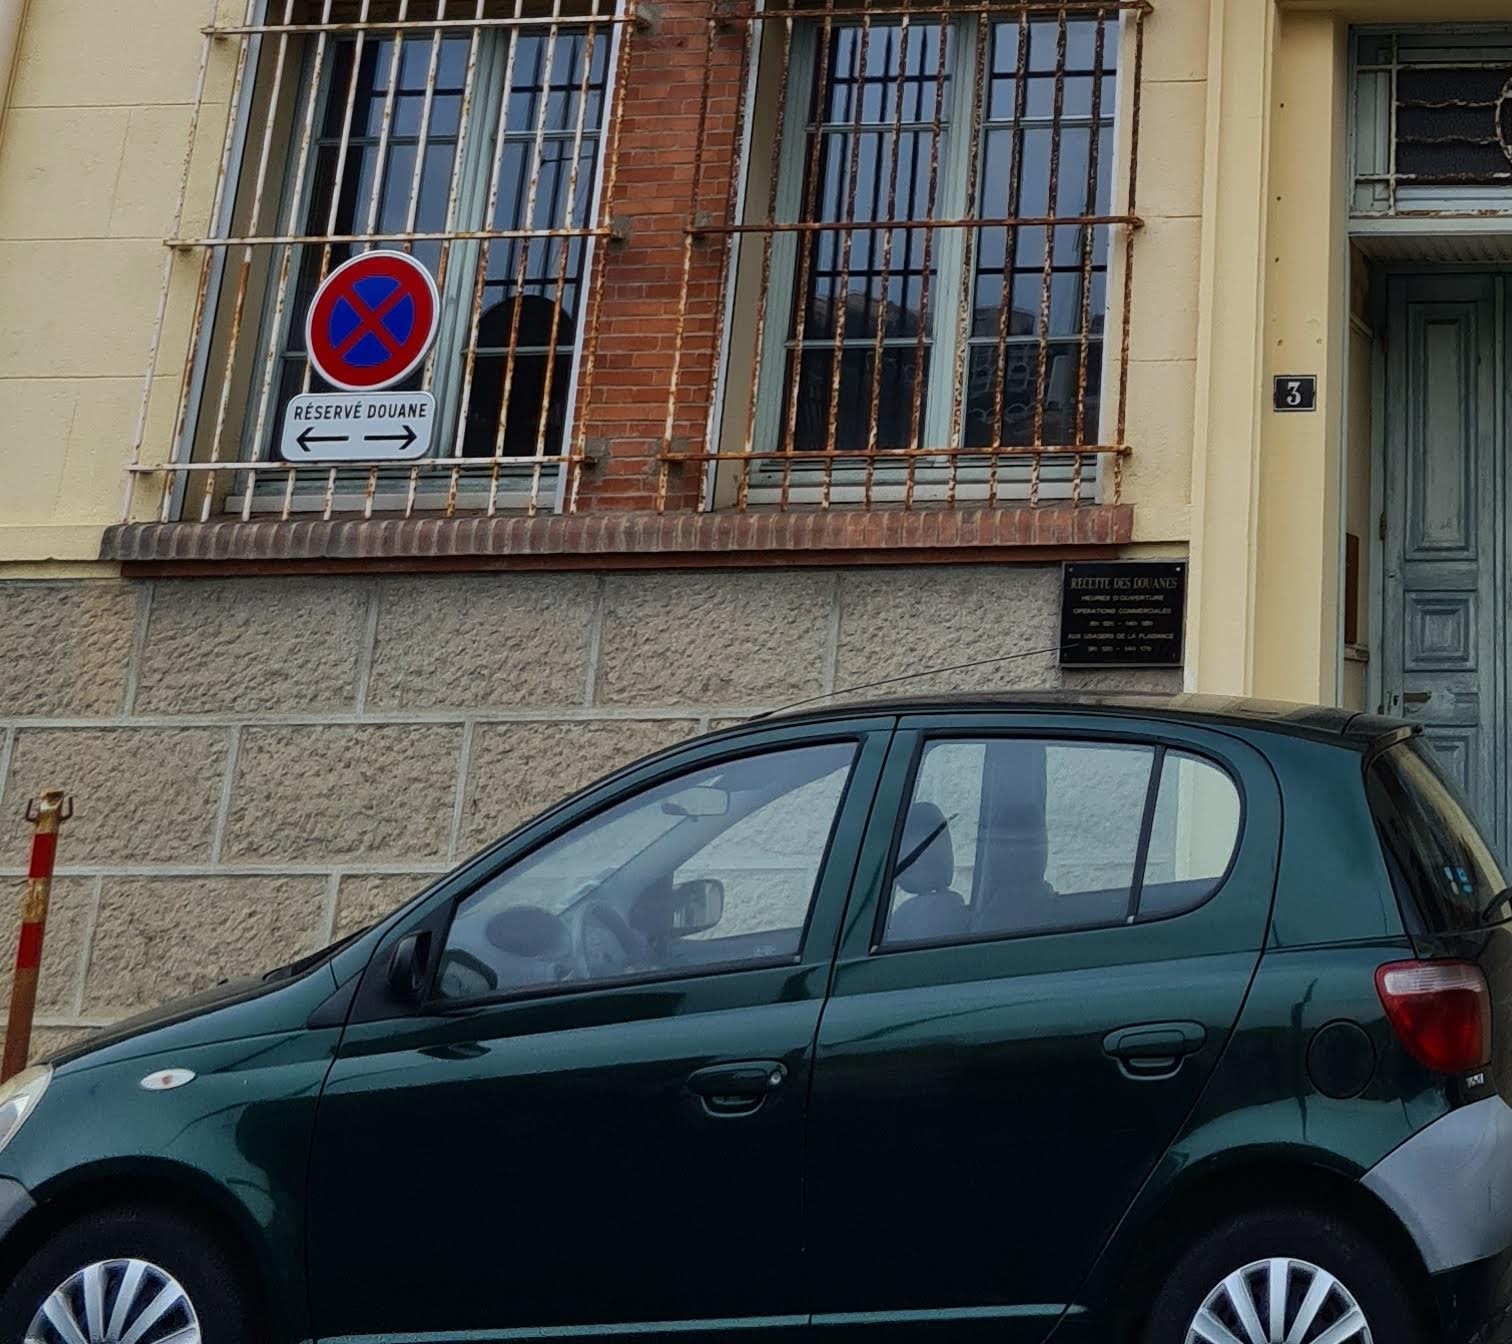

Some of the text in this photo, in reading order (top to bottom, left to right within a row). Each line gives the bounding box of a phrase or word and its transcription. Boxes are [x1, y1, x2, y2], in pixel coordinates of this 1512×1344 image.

[1287, 381, 1301, 405] 3
[294, 401, 428, 420] RÉSERVÉ DOUANE
[1071, 577, 1178, 589] RECETTE DES DOUANES
